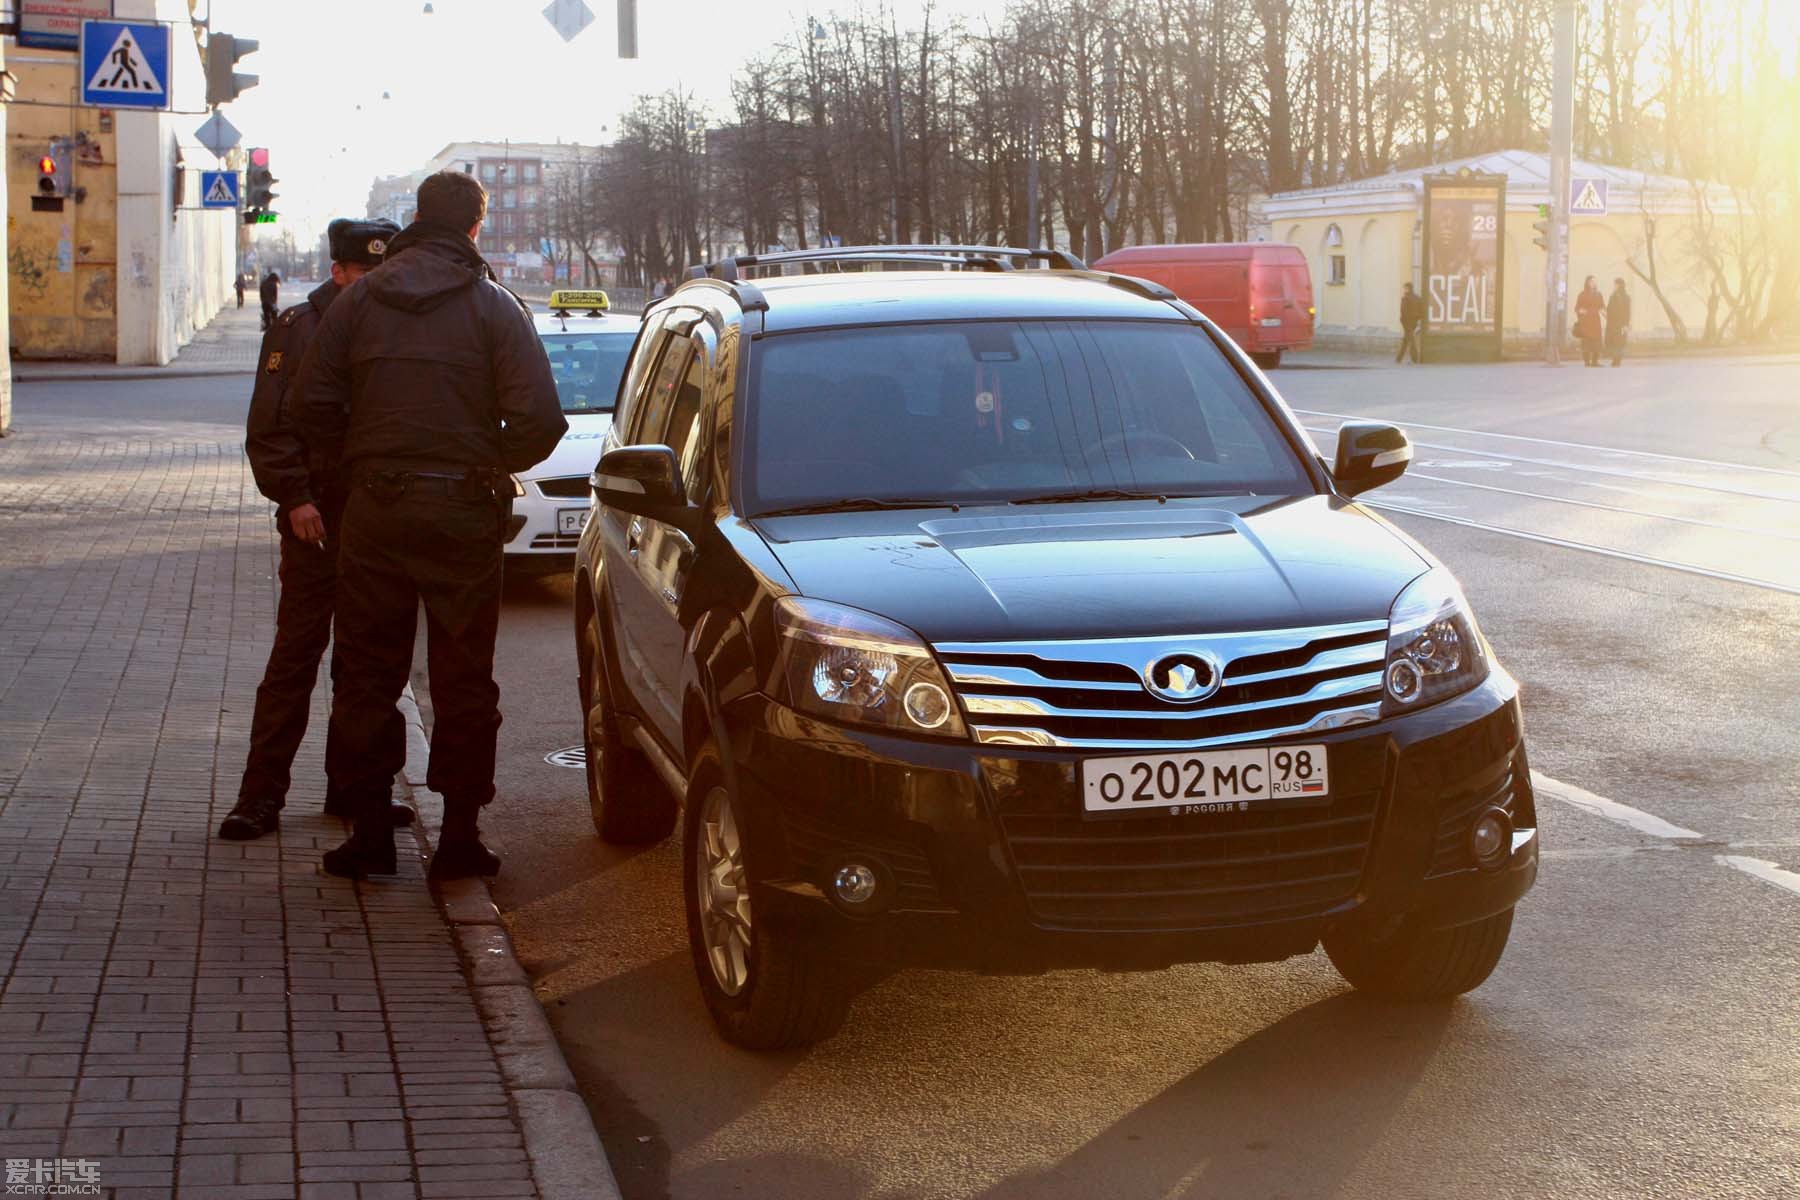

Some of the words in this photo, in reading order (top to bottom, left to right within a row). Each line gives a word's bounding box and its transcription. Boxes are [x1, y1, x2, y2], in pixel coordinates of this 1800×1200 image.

[1473, 215, 1497, 231] 28
[1428, 274, 1495, 323] SEAL
[1274, 750, 1313, 781] 98
[1273, 781, 1301, 793] RUS
